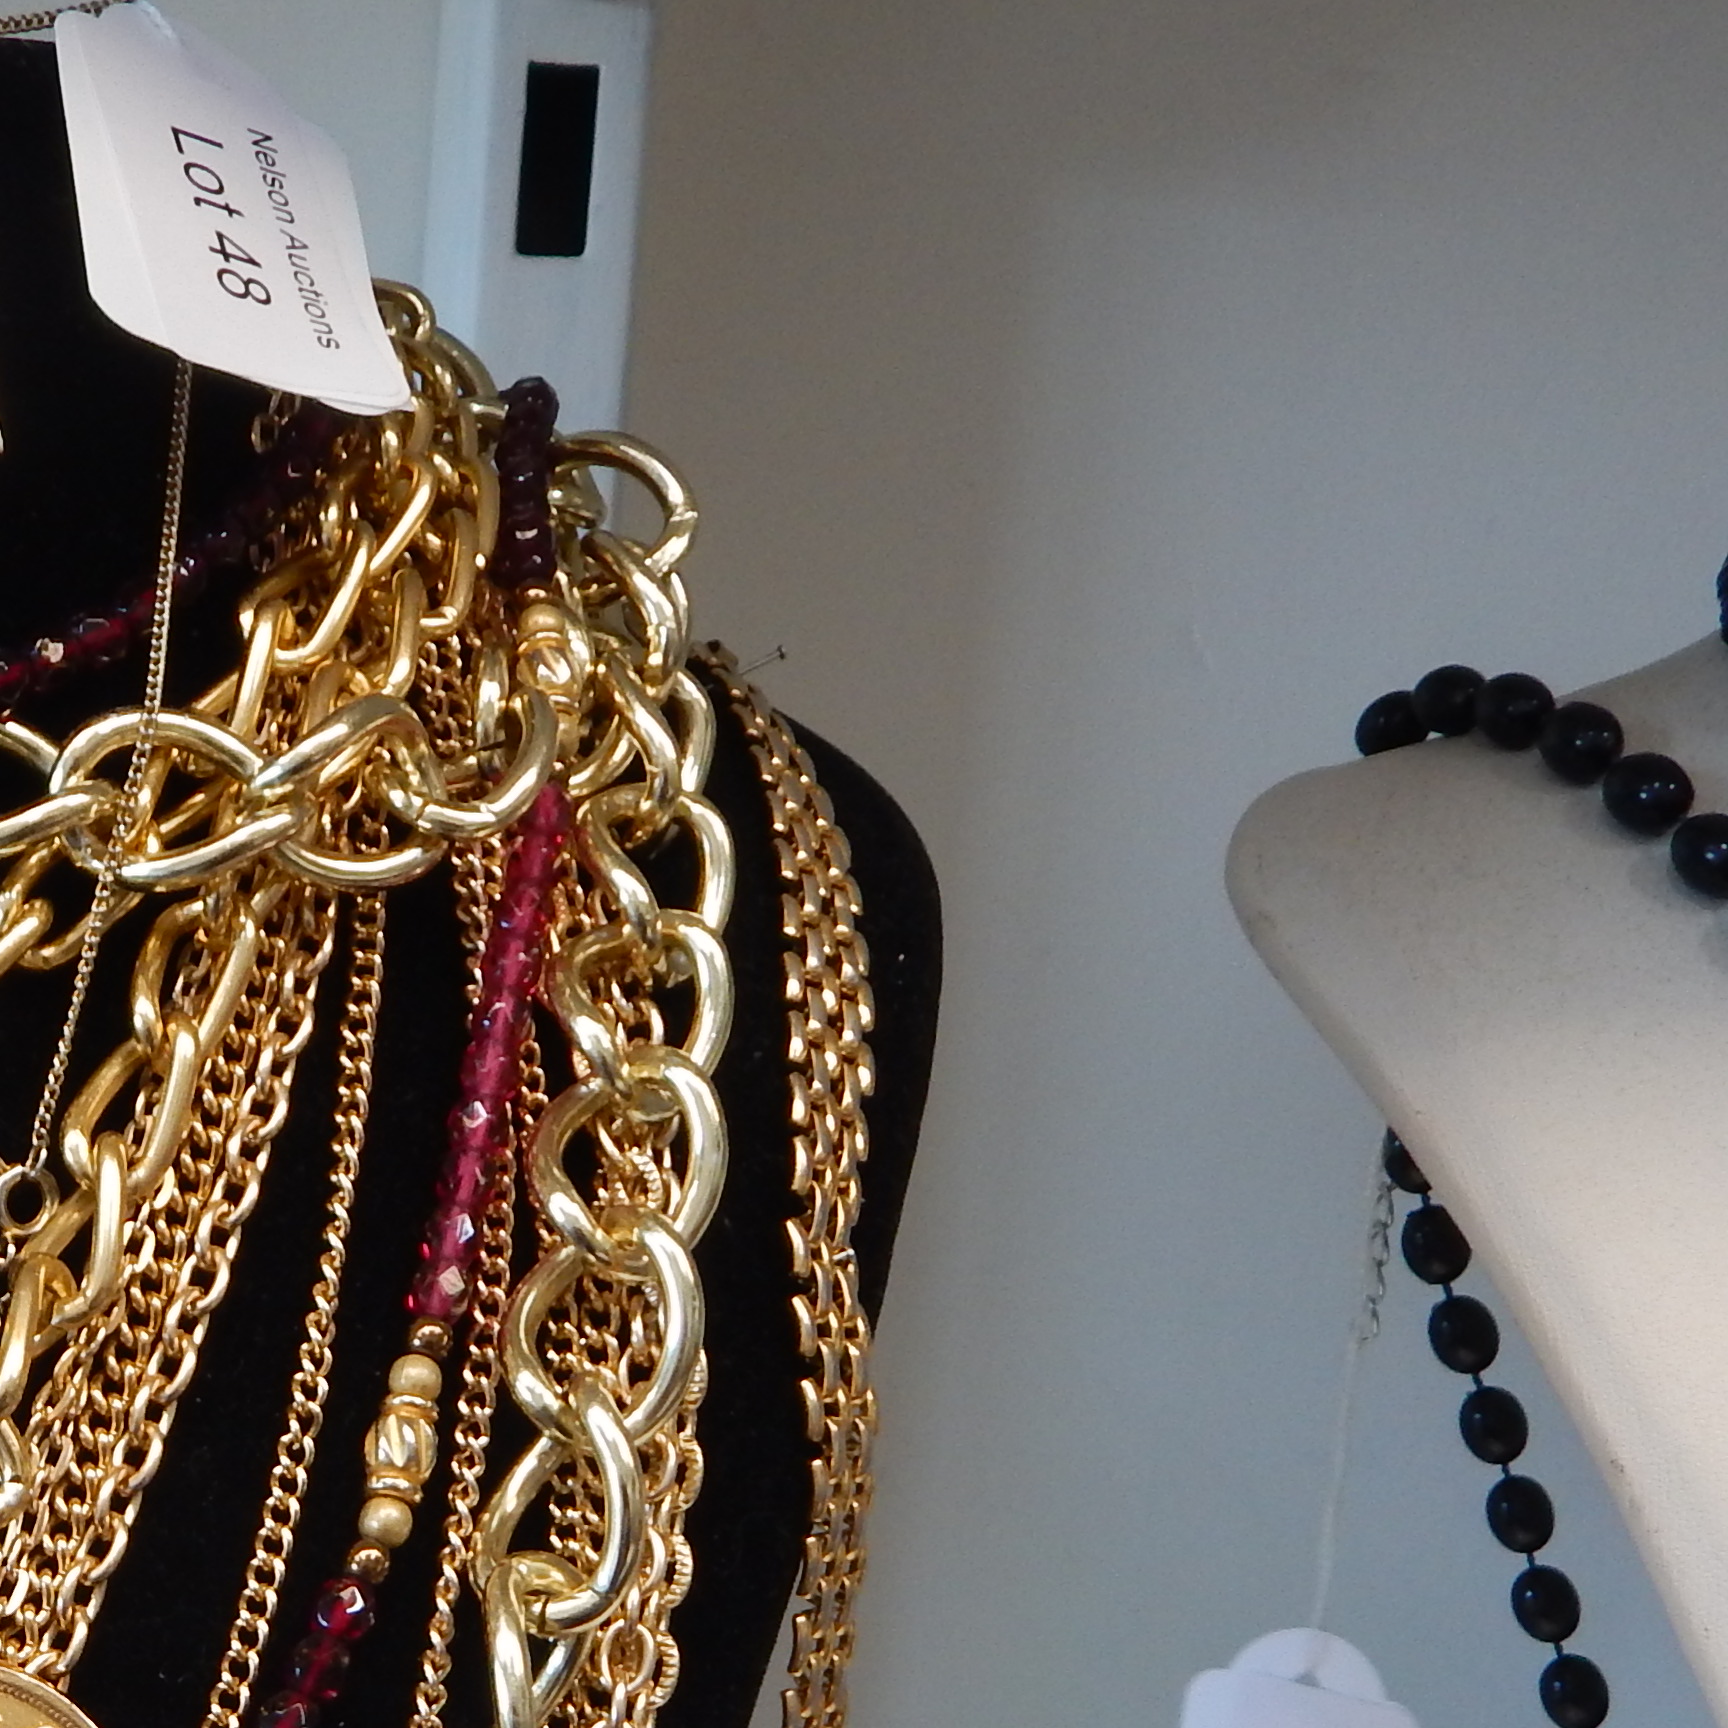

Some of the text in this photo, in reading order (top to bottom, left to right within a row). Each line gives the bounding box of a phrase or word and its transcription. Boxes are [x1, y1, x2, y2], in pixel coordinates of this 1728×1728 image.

[170, 125, 272, 306] Lot 48
[247, 127, 340, 351] Nelson Auctions
